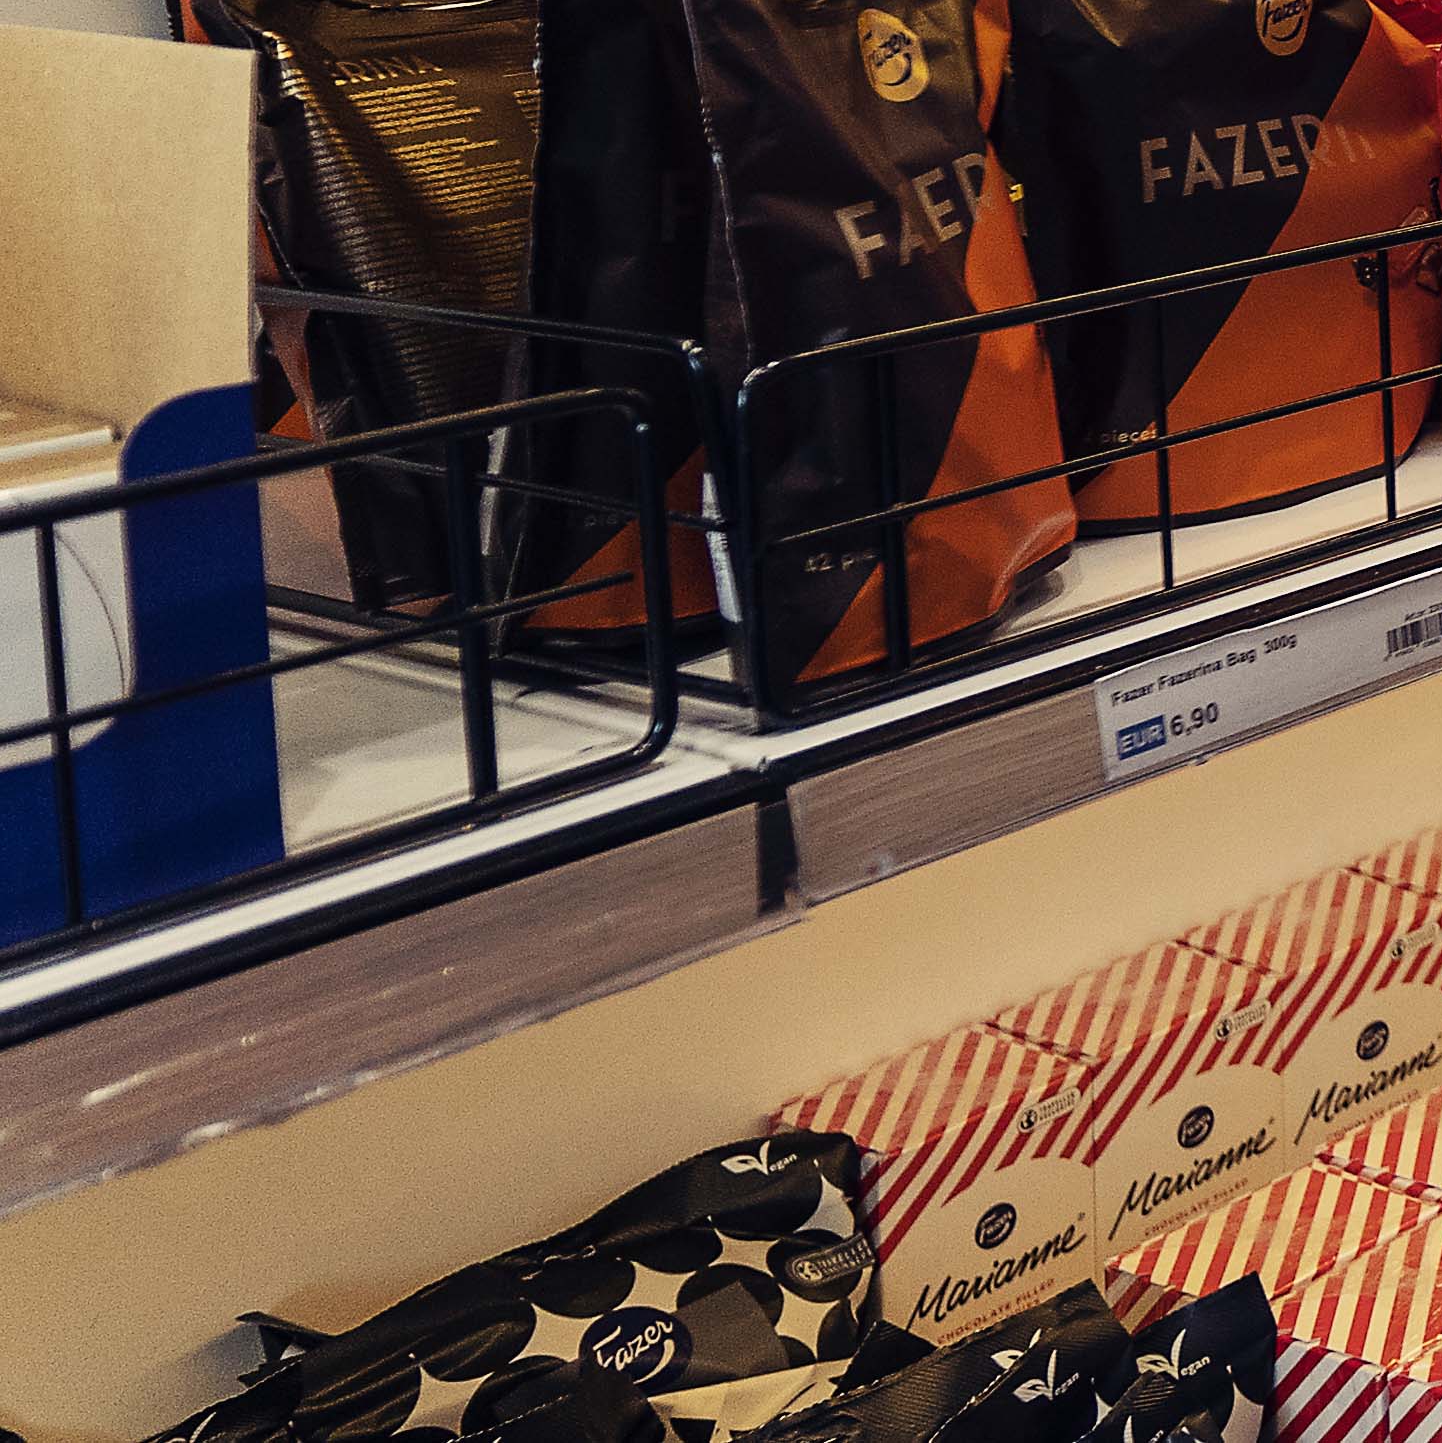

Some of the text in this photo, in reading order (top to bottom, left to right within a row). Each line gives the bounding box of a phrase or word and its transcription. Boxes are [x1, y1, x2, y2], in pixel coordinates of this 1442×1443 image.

[1111, 632, 1298, 706] Fazer Fazerina Bag 300g
[1118, 701, 1220, 753] EUR 6,90
[1108, 1124, 1278, 1242] Marianne
[905, 1222, 1087, 1334] Marianne
[592, 1318, 673, 1372] Fazer
